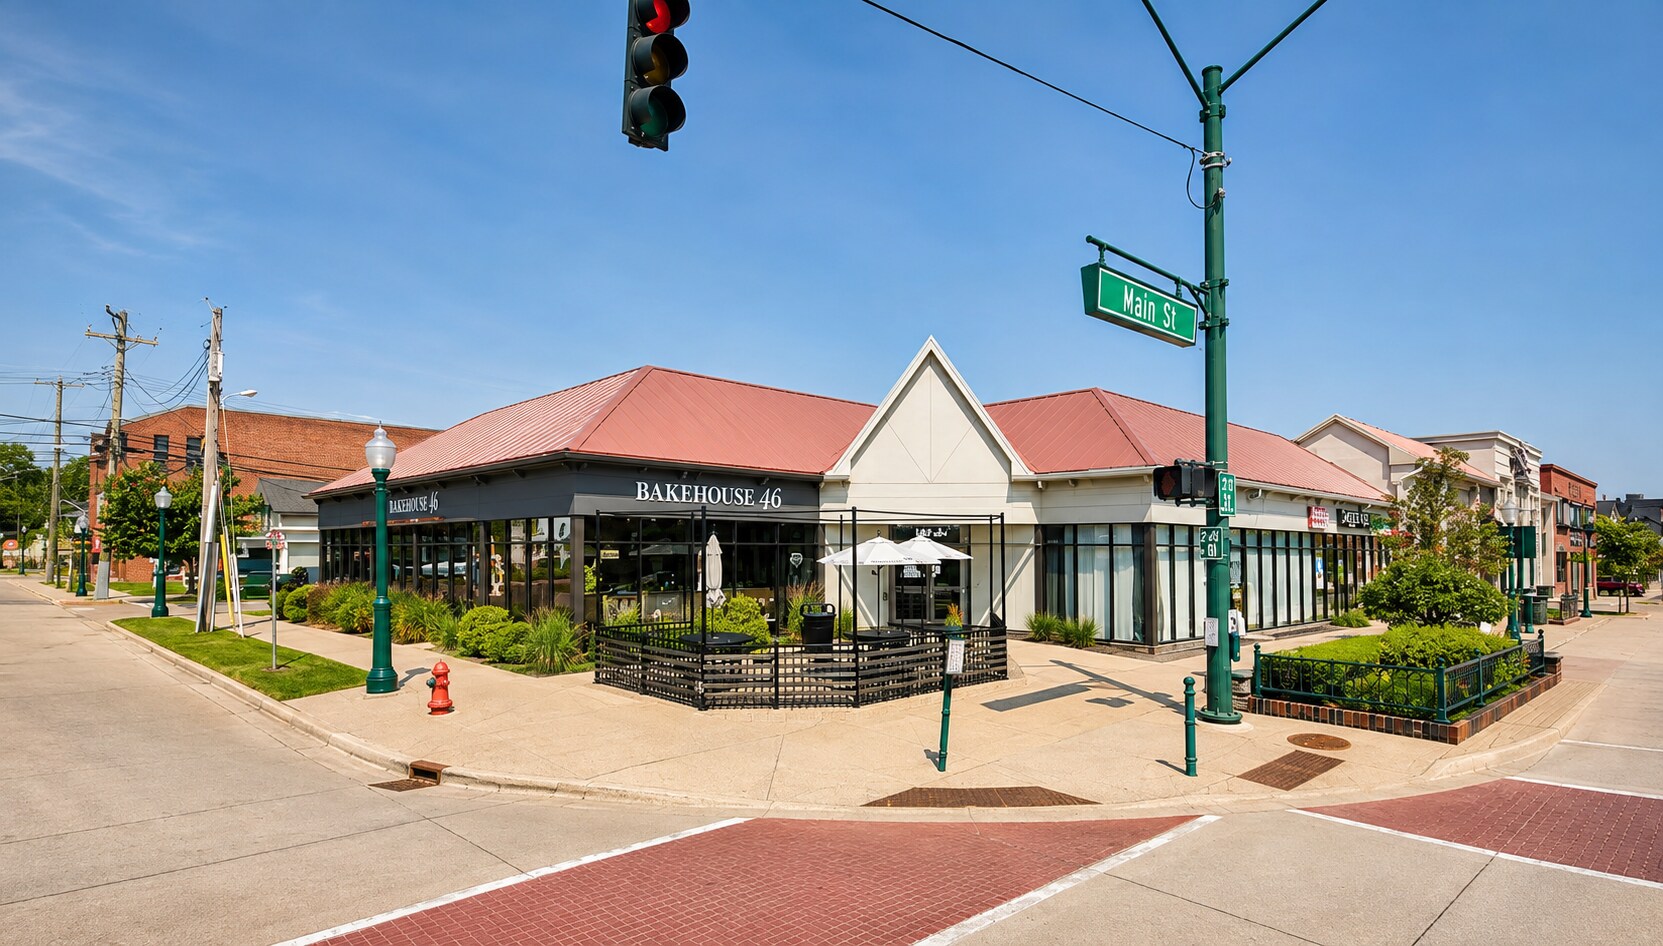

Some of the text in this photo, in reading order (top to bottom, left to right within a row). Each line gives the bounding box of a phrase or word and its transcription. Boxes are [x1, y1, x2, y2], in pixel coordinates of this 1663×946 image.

[1123, 285, 1177, 331] Main St
[428, 491, 439, 514] 46
[635, 481, 782, 510] BAKEHOUSE 46
